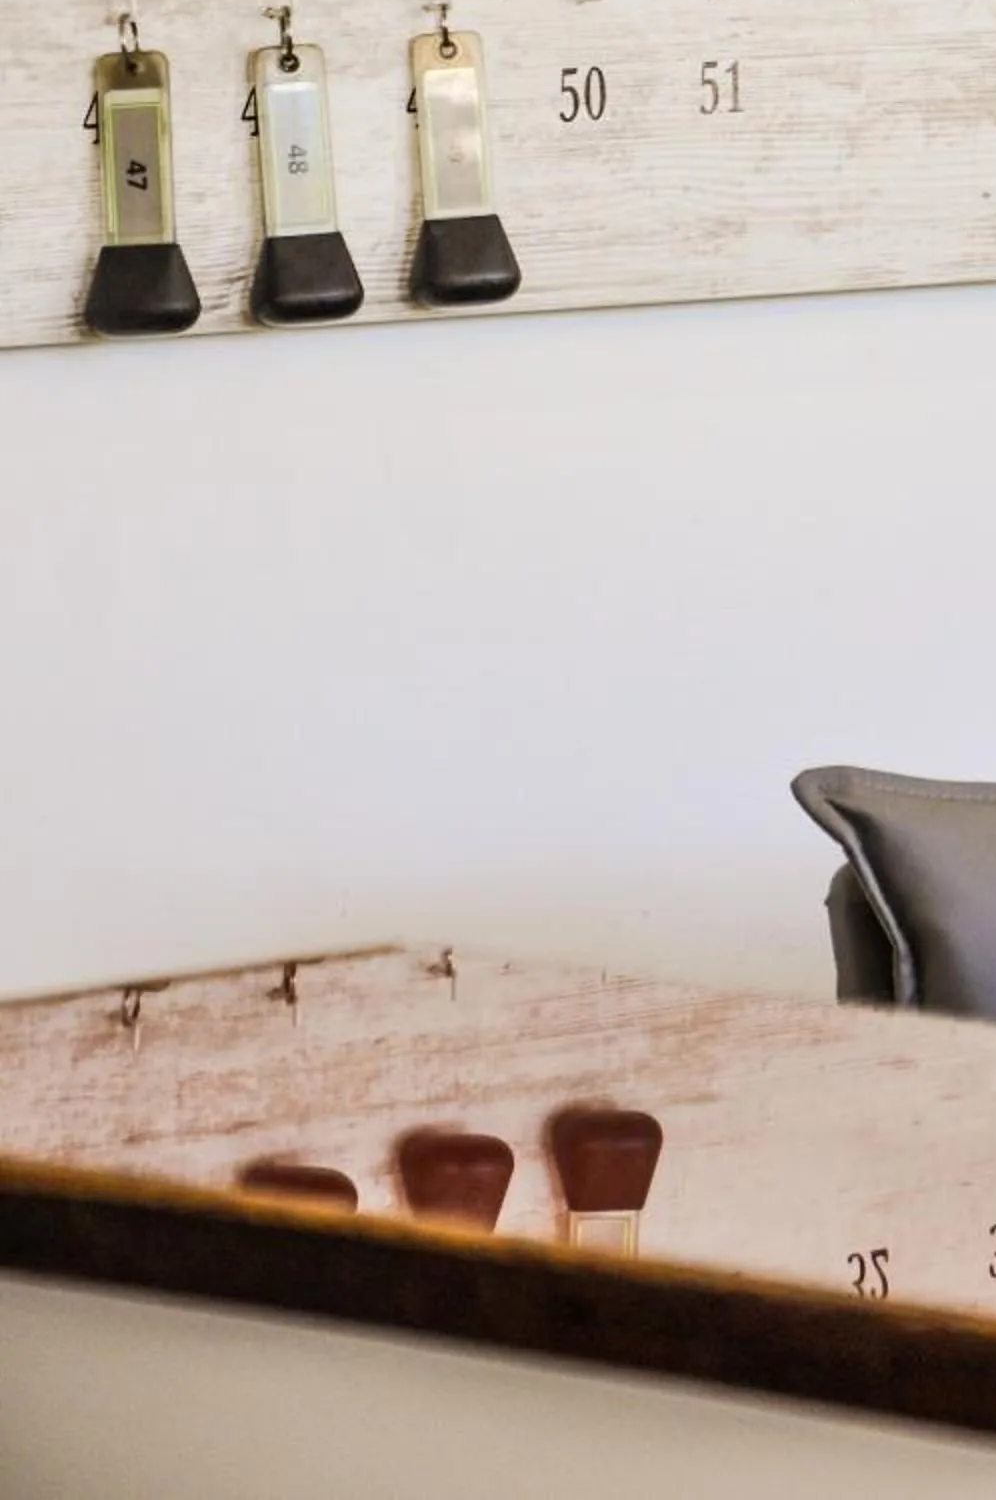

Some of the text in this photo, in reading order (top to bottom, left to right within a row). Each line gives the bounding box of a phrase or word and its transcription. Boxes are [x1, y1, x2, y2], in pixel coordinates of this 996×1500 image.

[241, 85, 259, 137] 4
[559, 66, 607, 122] 50
[699, 60, 745, 115] 51
[125, 159, 149, 192] 47
[287, 144, 309, 175] 48
